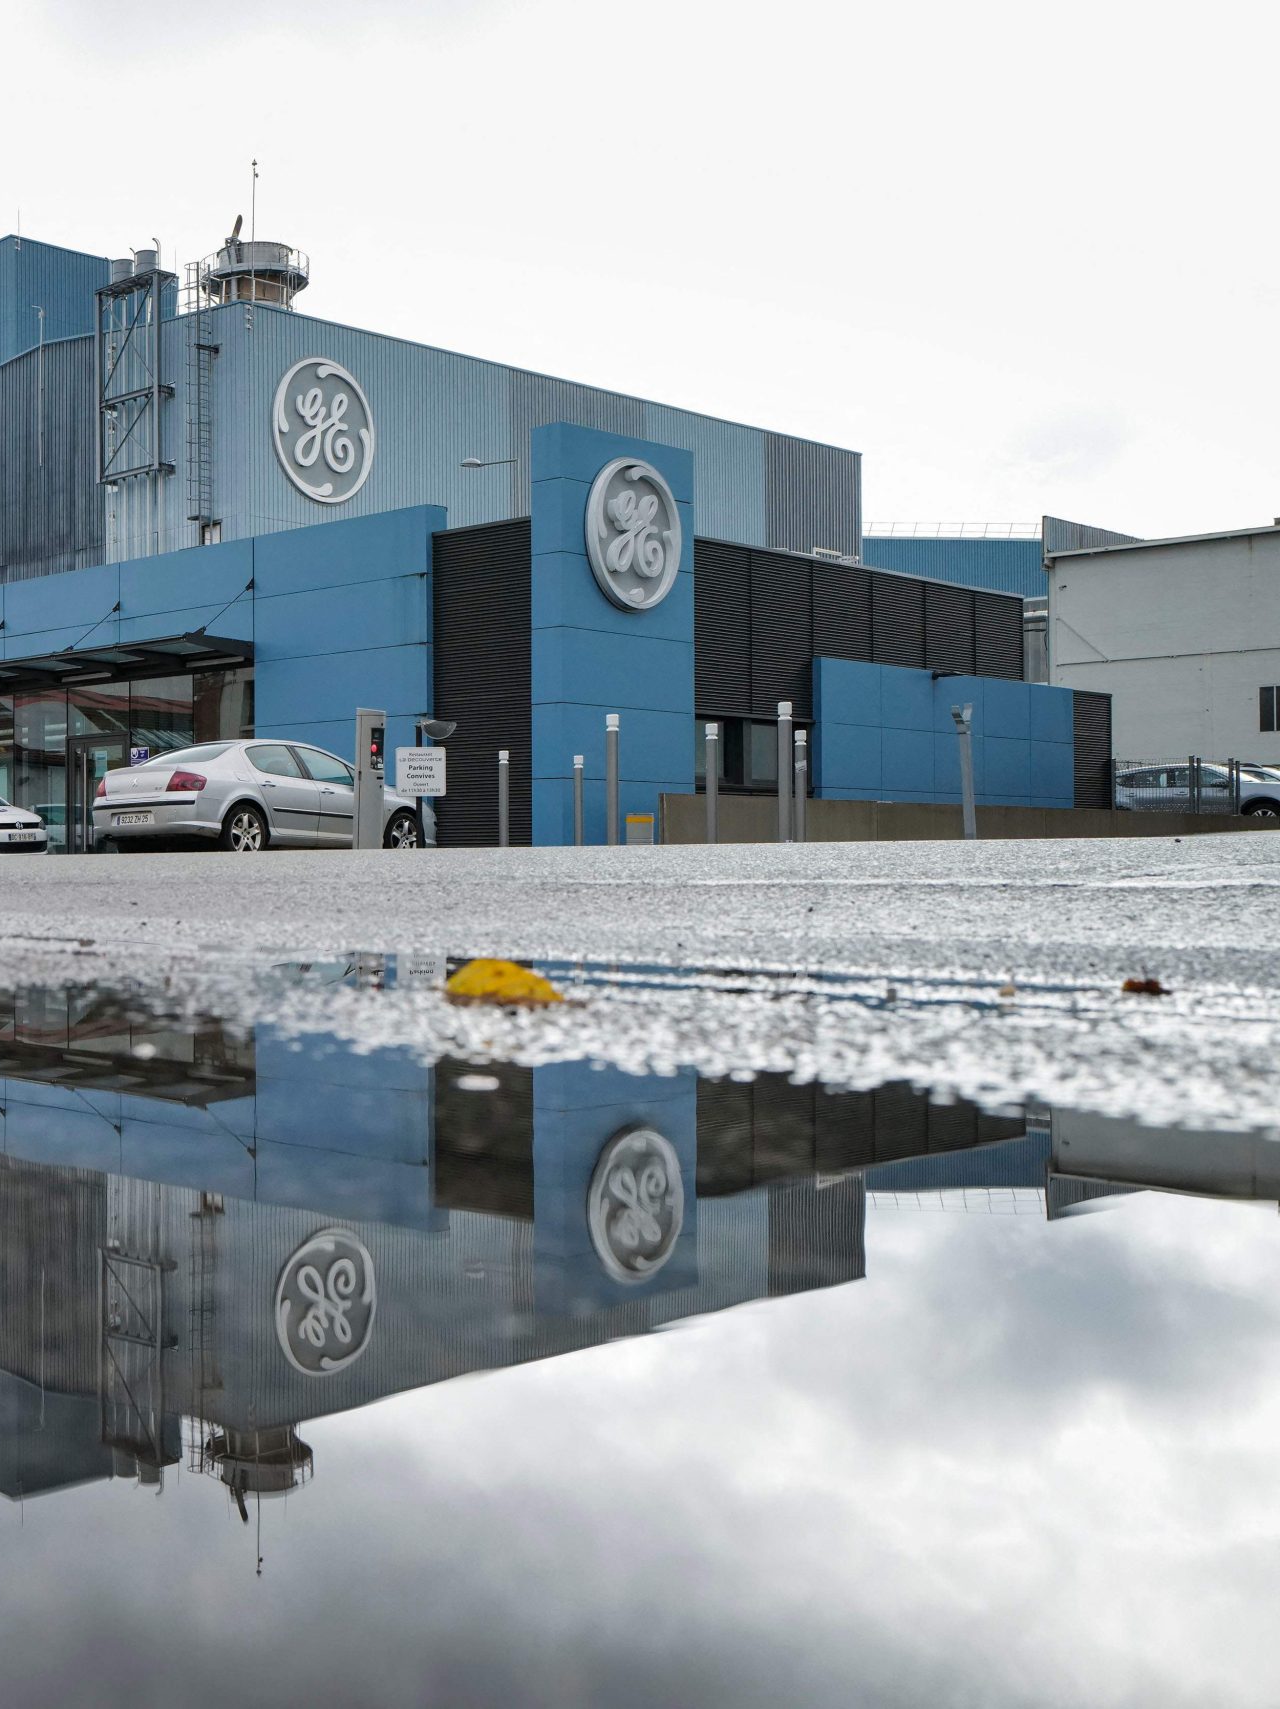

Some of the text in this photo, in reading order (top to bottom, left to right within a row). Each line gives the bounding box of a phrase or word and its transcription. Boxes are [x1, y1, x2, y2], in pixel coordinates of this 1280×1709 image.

[121, 814, 149, 824] 9232 ZH 25
